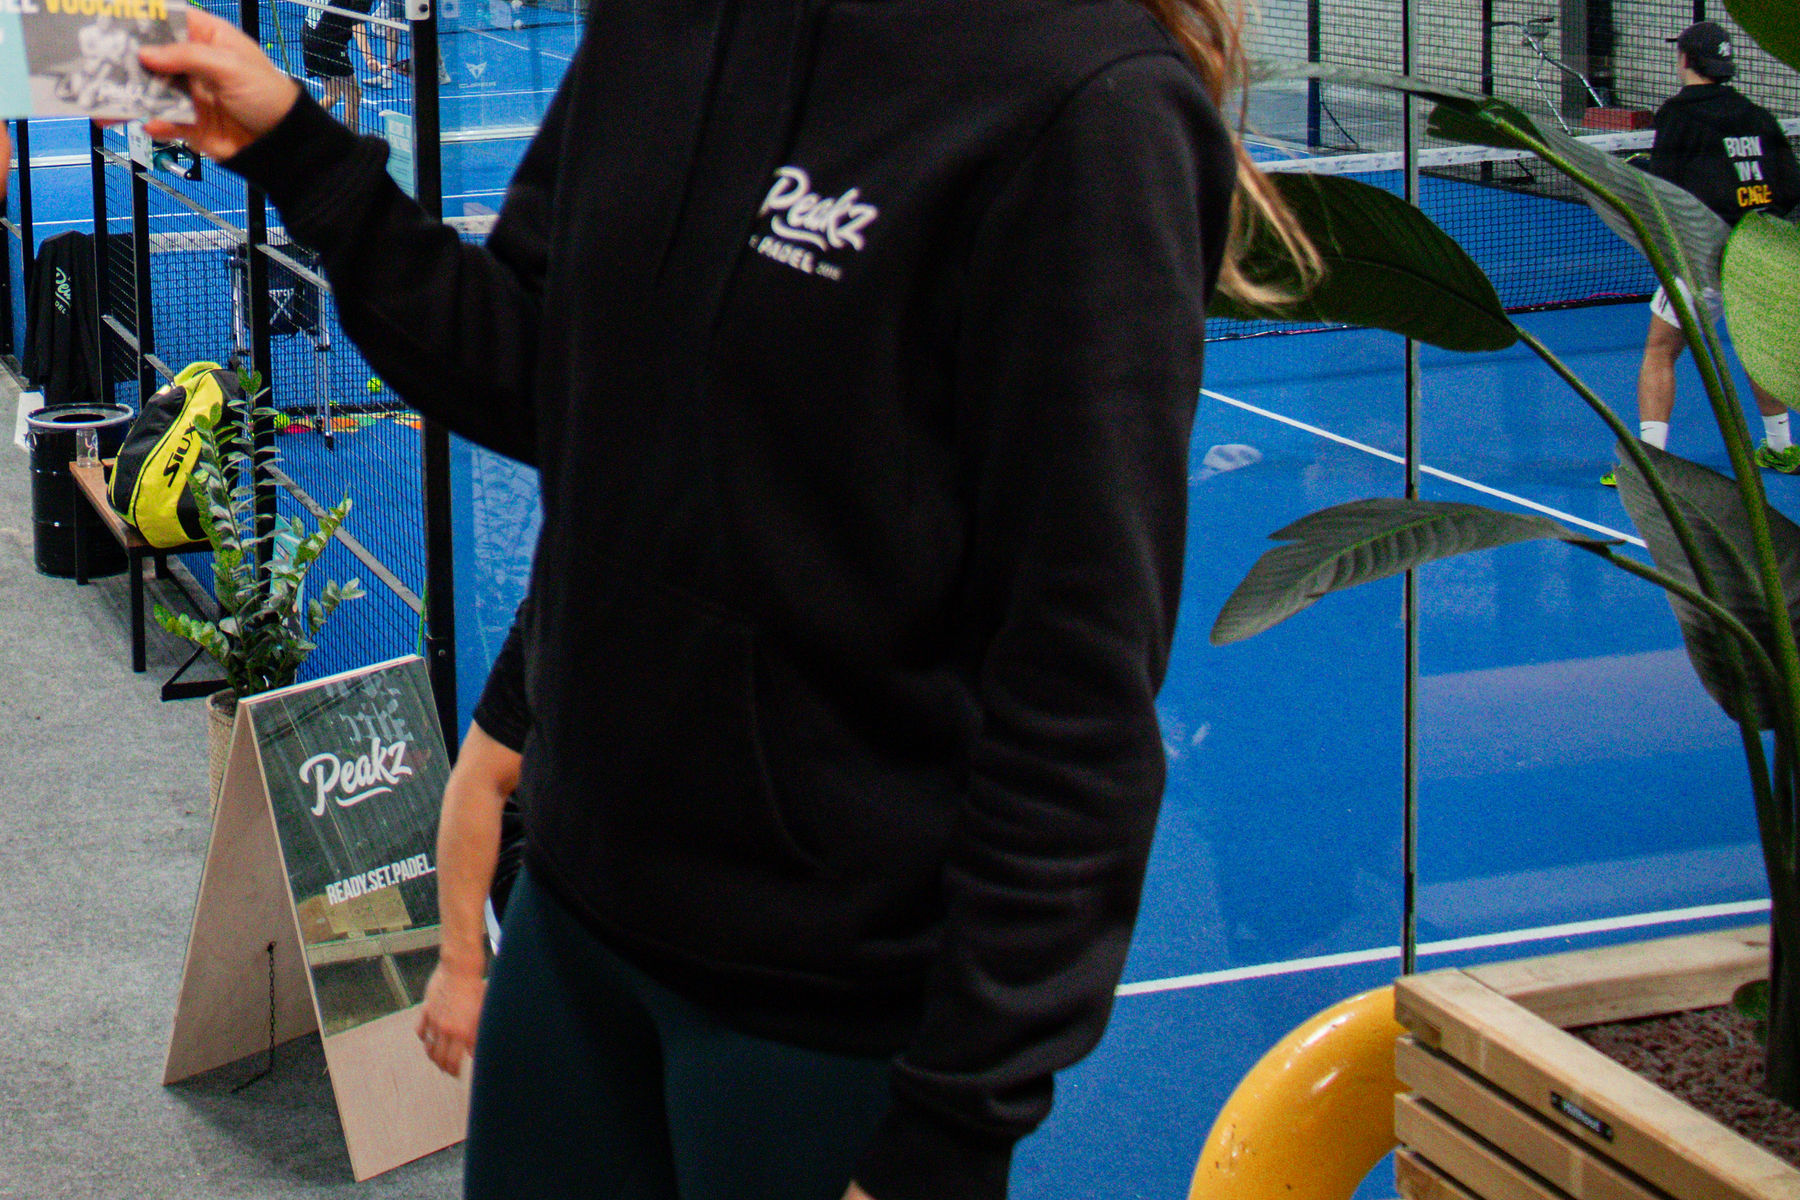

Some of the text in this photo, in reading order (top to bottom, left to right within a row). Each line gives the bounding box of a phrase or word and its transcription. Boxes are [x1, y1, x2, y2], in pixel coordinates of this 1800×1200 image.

[757, 165, 879, 252] Peakz
[298, 736, 413, 817] Peakz
[325, 852, 437, 906] READY.SET.PADEL.
